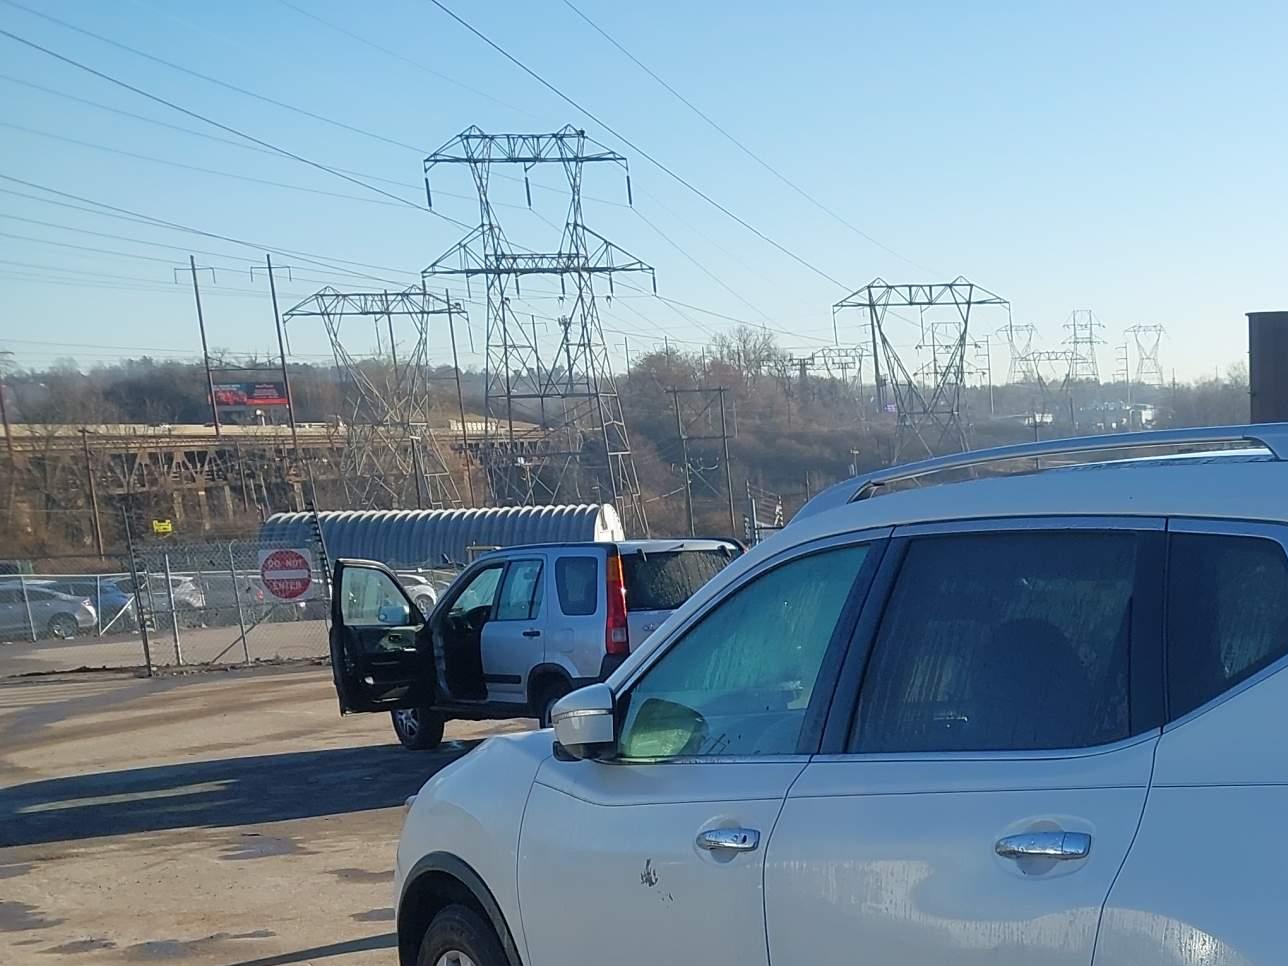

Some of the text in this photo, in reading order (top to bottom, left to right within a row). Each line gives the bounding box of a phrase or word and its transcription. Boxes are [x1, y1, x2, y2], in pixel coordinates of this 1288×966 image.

[267, 559, 303, 568] DO NOT
[272, 581, 302, 591] ENTER
